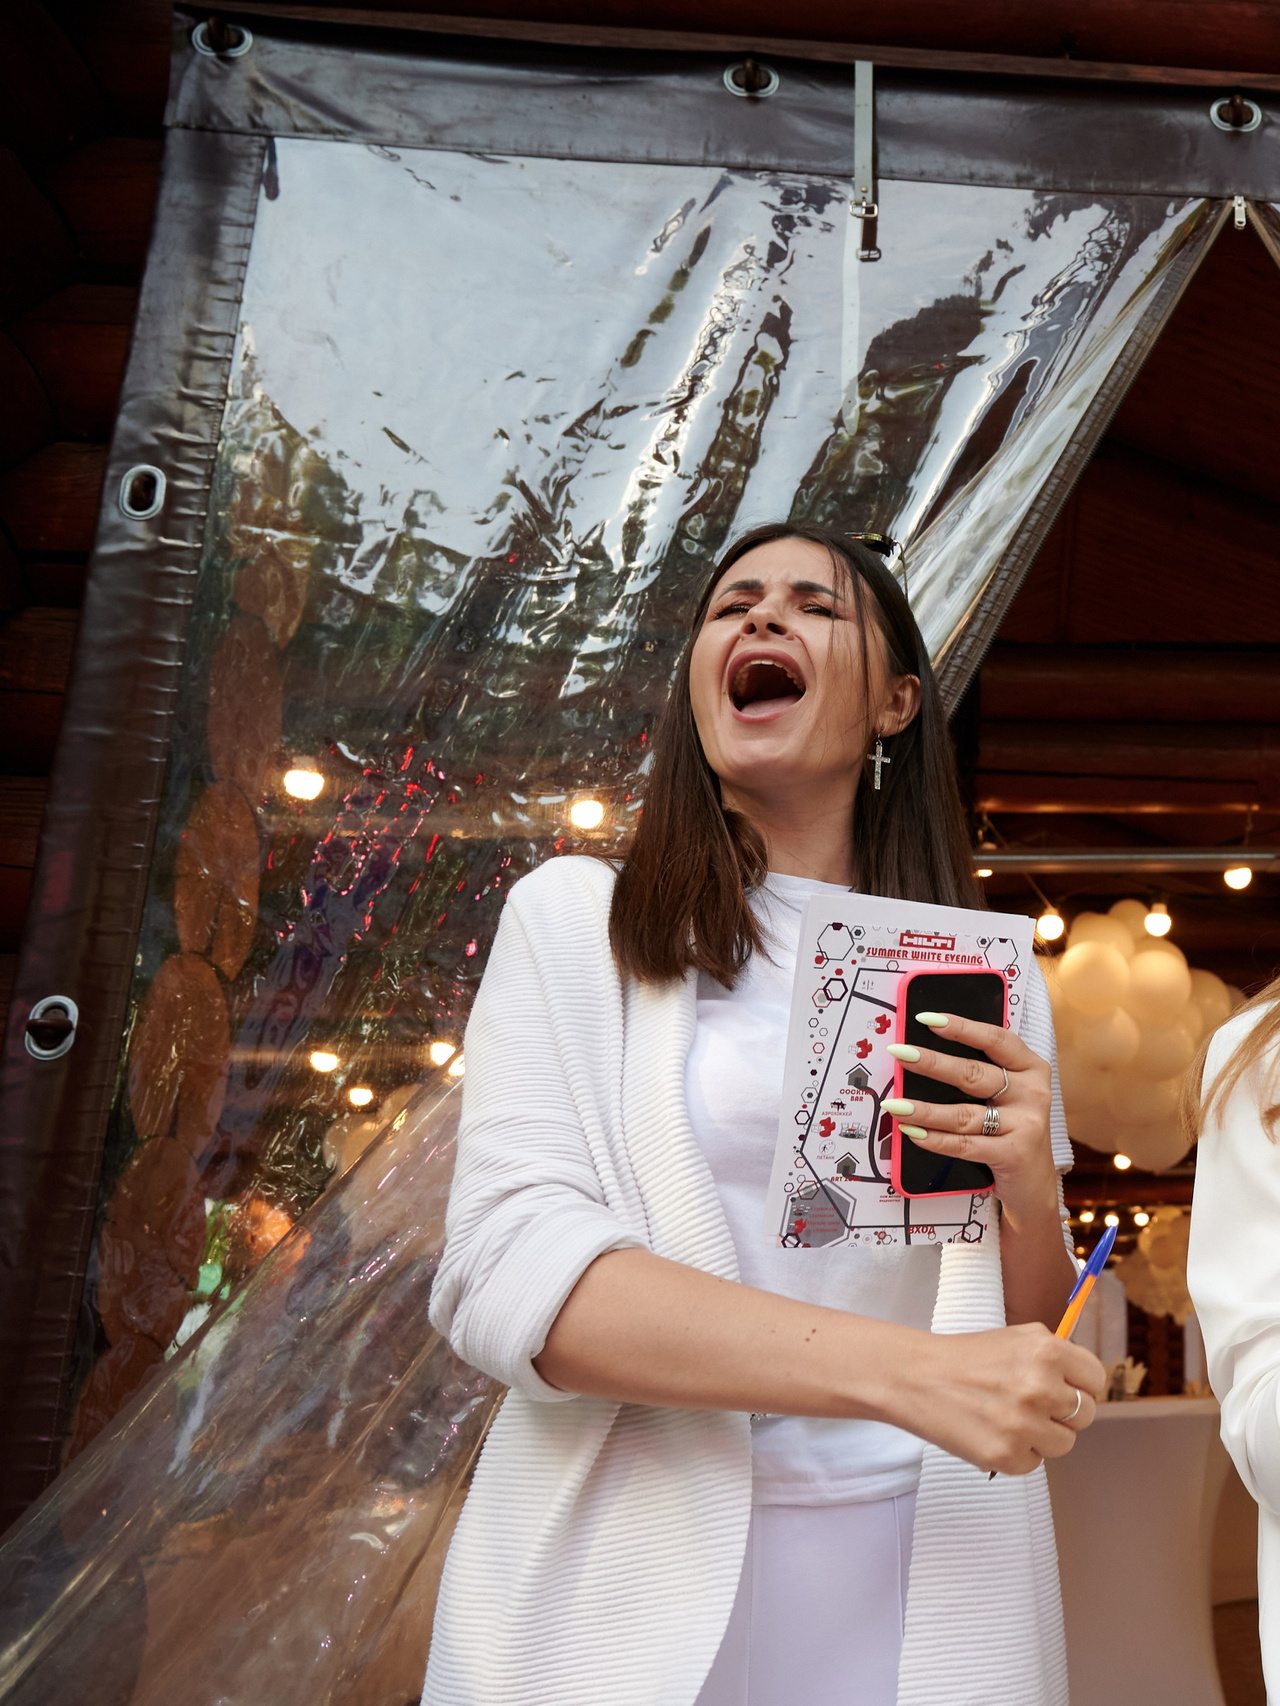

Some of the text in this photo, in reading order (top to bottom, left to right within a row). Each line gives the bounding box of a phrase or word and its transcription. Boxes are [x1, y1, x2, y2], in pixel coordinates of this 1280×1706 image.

[902, 935, 953, 949] HILTI
[866, 947, 984, 965] SUMMER WHITE EVENING
[908, 1224, 936, 1235] ВХОД
